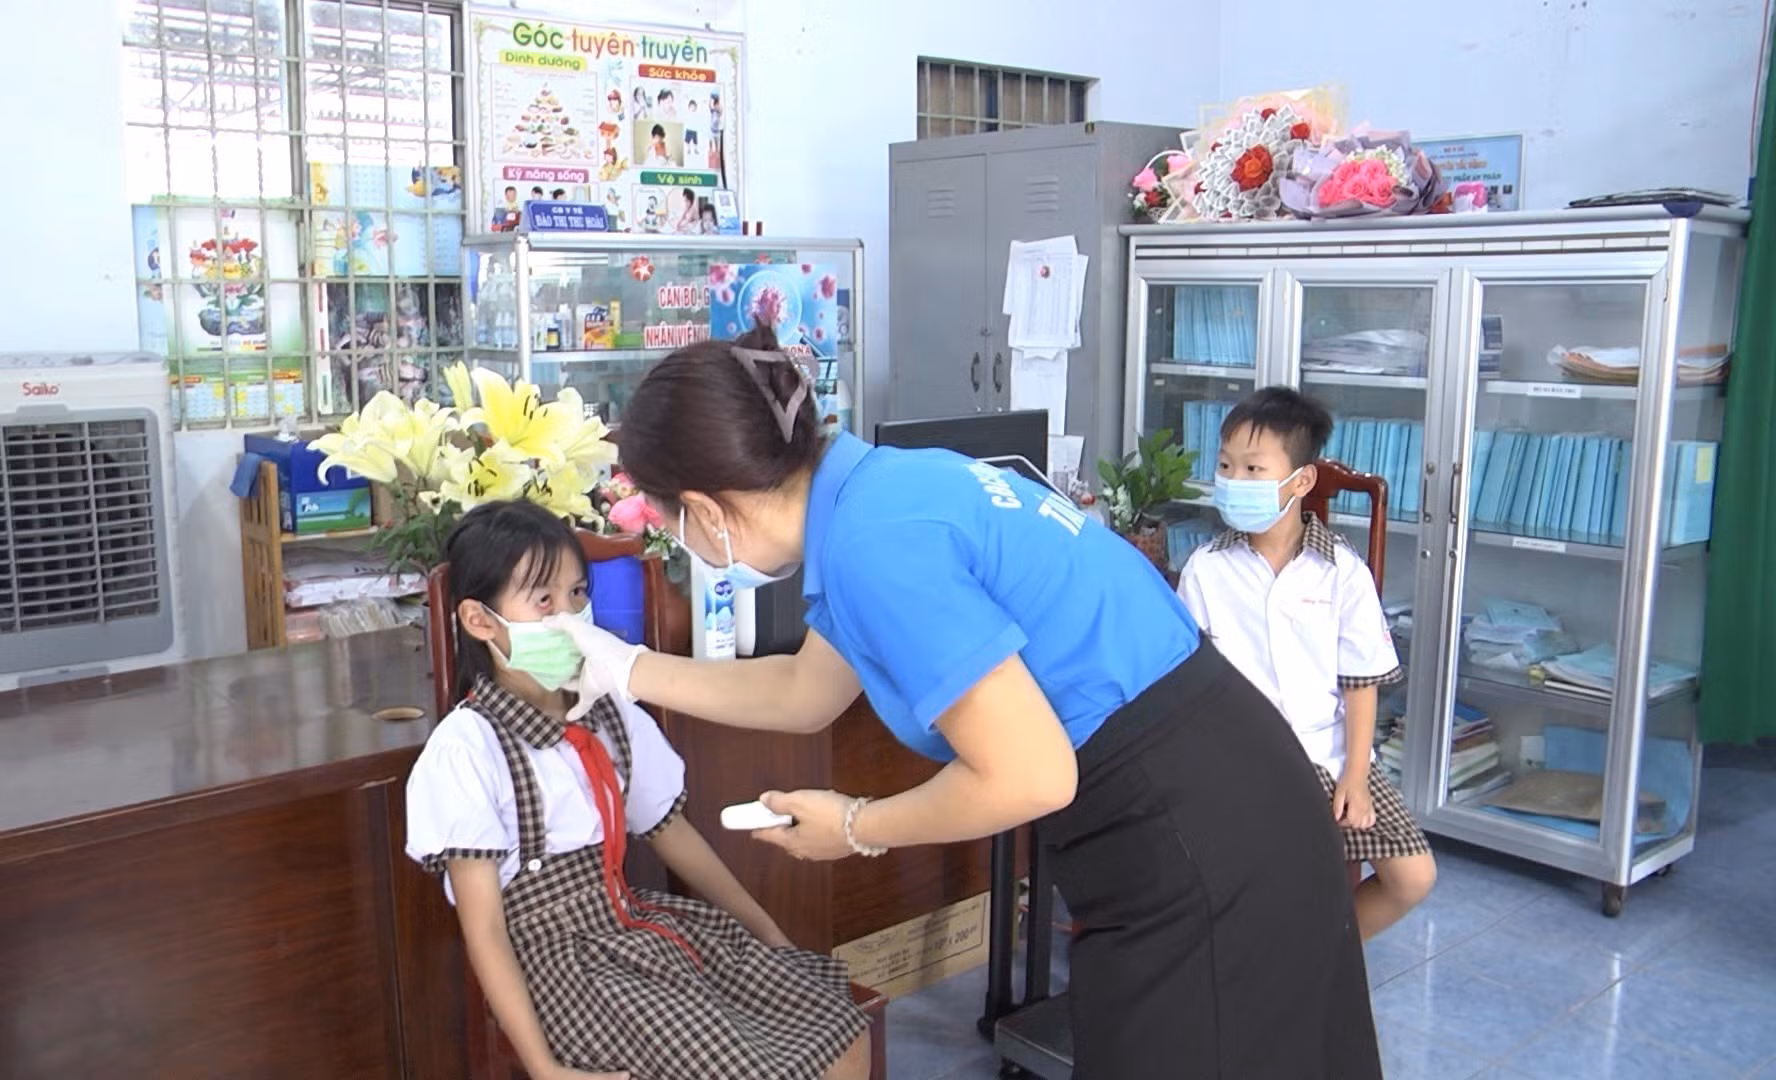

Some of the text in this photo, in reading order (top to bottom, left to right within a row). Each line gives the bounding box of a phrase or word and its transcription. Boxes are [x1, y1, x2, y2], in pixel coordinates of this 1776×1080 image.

[513, 22, 708, 65] Góc tuyên truyền
[505, 52, 581, 70] Dinh dưỡng
[648, 66, 707, 81] Sức khỏe
[508, 168, 585, 183] Kỹ năng sống
[657, 173, 703, 185] Vệ sinh
[644, 321, 675, 349] NHÂN
[22, 382, 59, 396] Saiko
